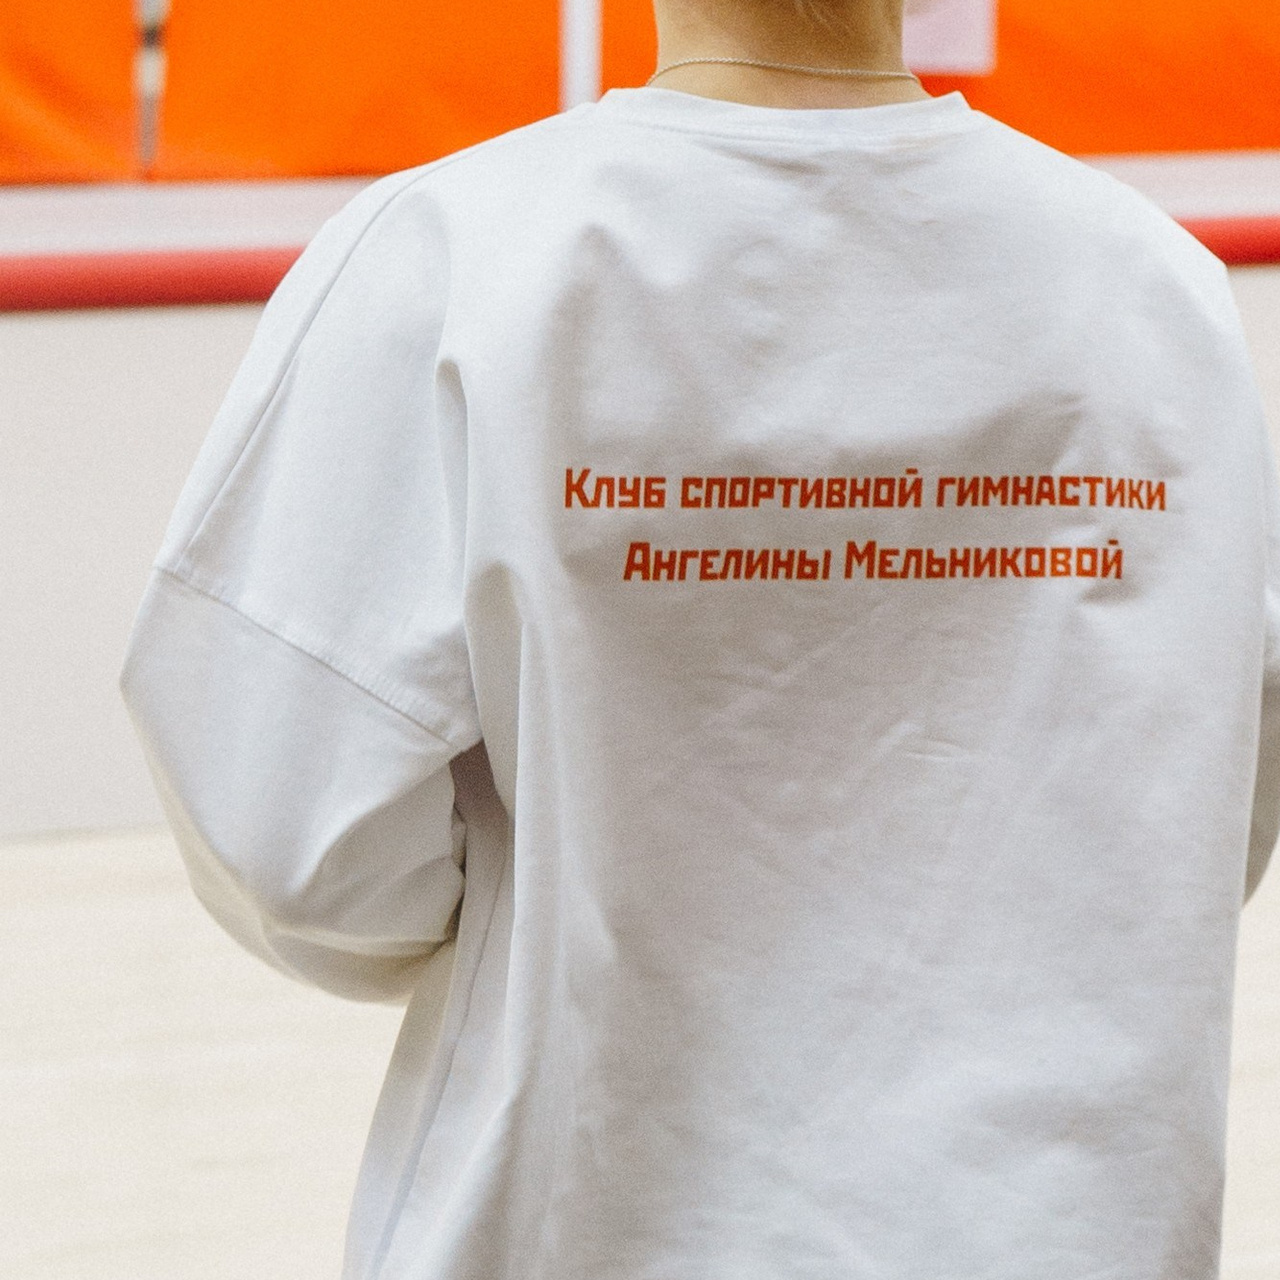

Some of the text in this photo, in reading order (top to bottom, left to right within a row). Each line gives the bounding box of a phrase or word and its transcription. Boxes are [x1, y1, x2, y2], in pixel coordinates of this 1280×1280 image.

[563, 467, 1166, 512] Клуб спортивной гимнастики
[622, 538, 1124, 582] Ангелины Мельниковой
